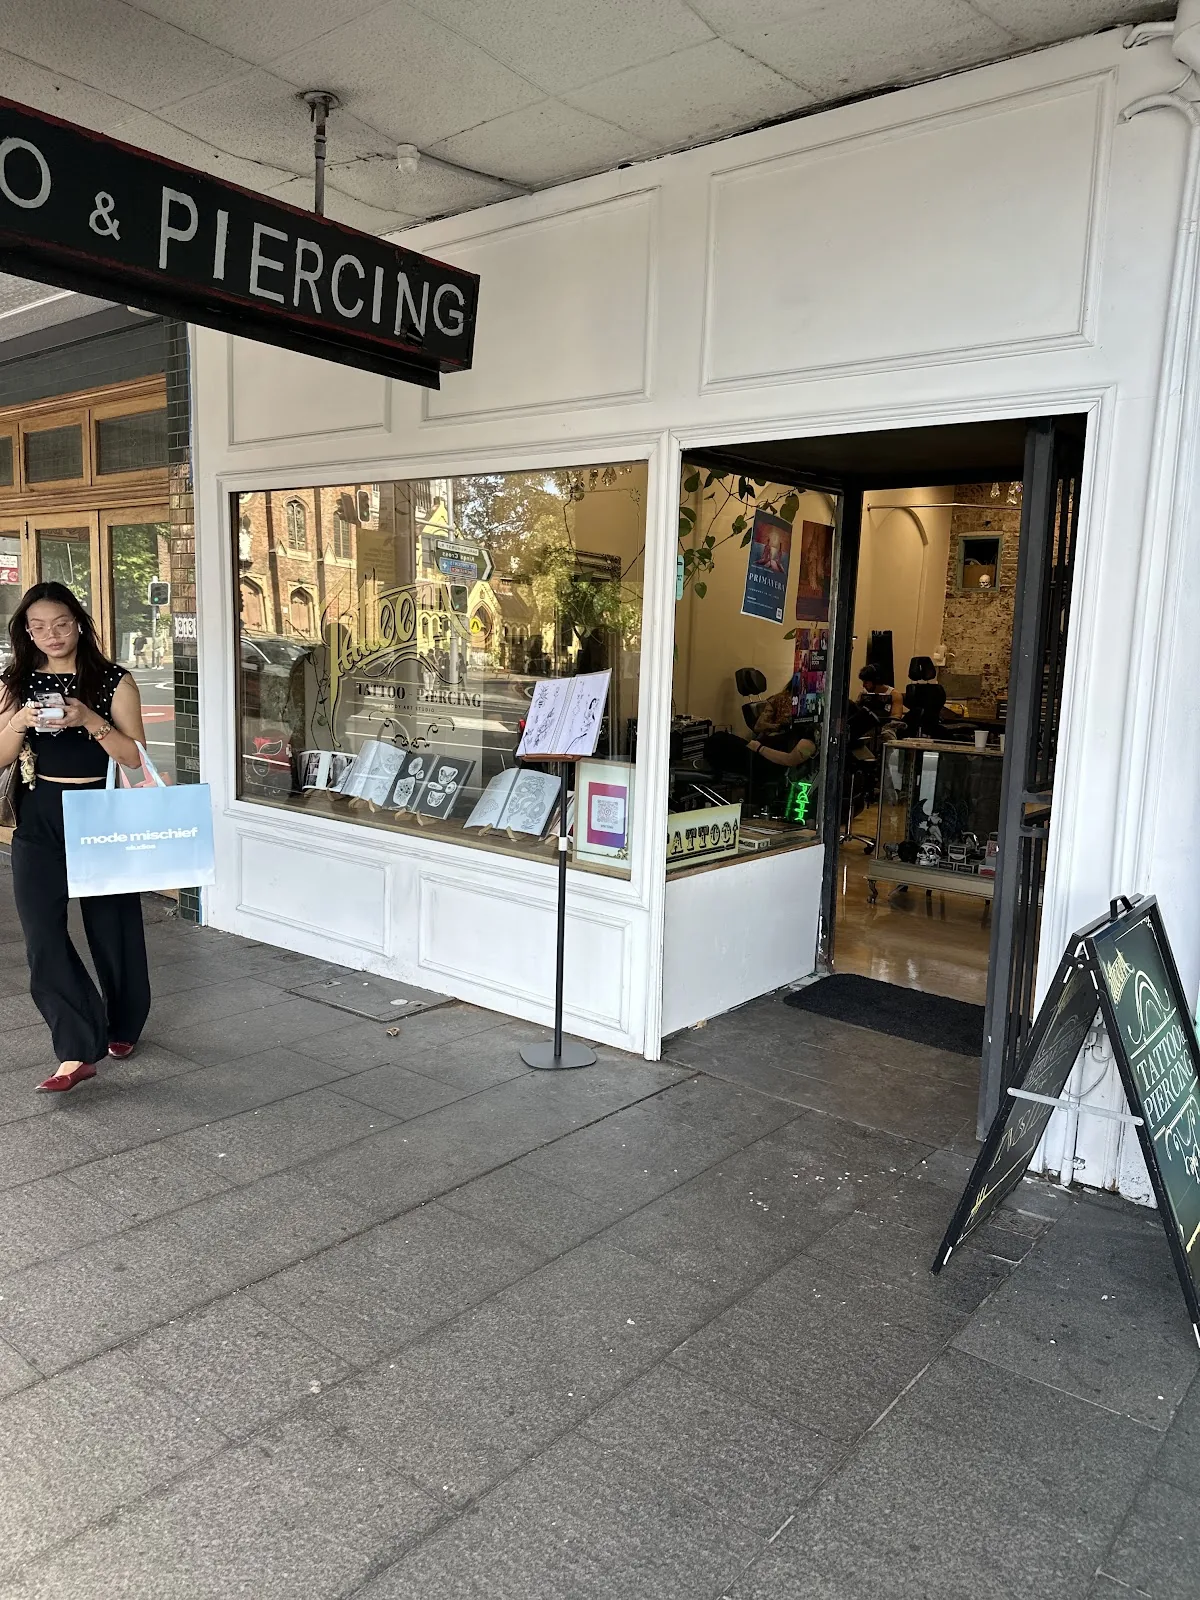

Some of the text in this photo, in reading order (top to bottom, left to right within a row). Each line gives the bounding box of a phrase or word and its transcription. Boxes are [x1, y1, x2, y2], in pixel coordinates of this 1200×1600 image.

[0, 136, 466, 338] O & PIERCING
[748, 572, 785, 592] PRIMAVERA
[178, 620, 193, 636] 213
[355, 682, 406, 700] TATTOO
[416, 688, 481, 708] PIERCING
[80, 826, 198, 845] mode mischief
[667, 821, 732, 855] ATTOO
[1143, 1049, 1194, 1130] PIERCING
